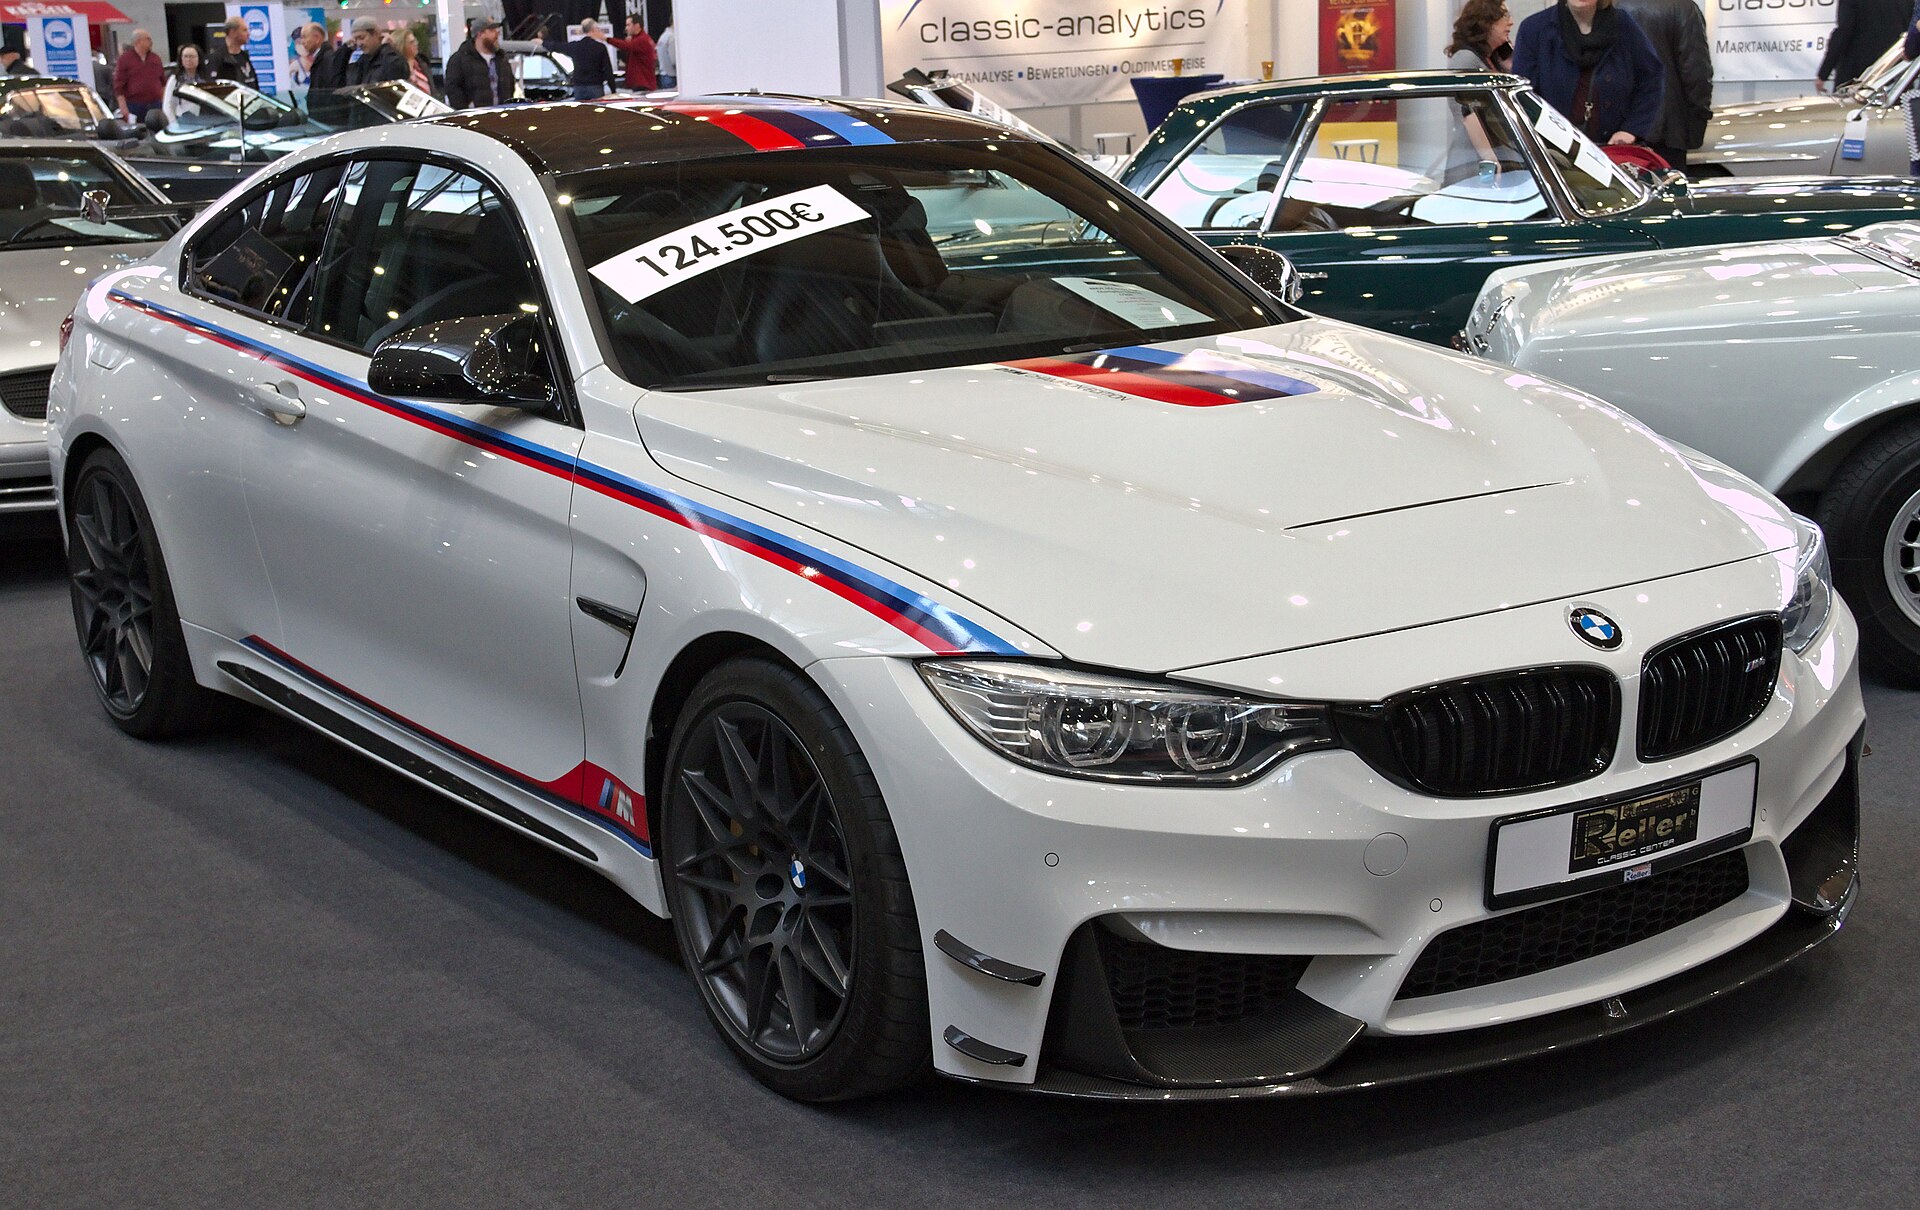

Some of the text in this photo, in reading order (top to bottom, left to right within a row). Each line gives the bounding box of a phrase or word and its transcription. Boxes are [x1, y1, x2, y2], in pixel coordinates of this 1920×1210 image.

[920, 6, 1206, 43] classic-analytics
[1715, 37, 1829, 54] MARKTANALYSE B
[1026, 65, 1110, 81] BEWERTUNGEN
[1120, 57, 1206, 75] OLDTIMERREISE
[635, 202, 825, 277] 124.500€
[1597, 838, 1675, 865] CLASSIC CENTER
